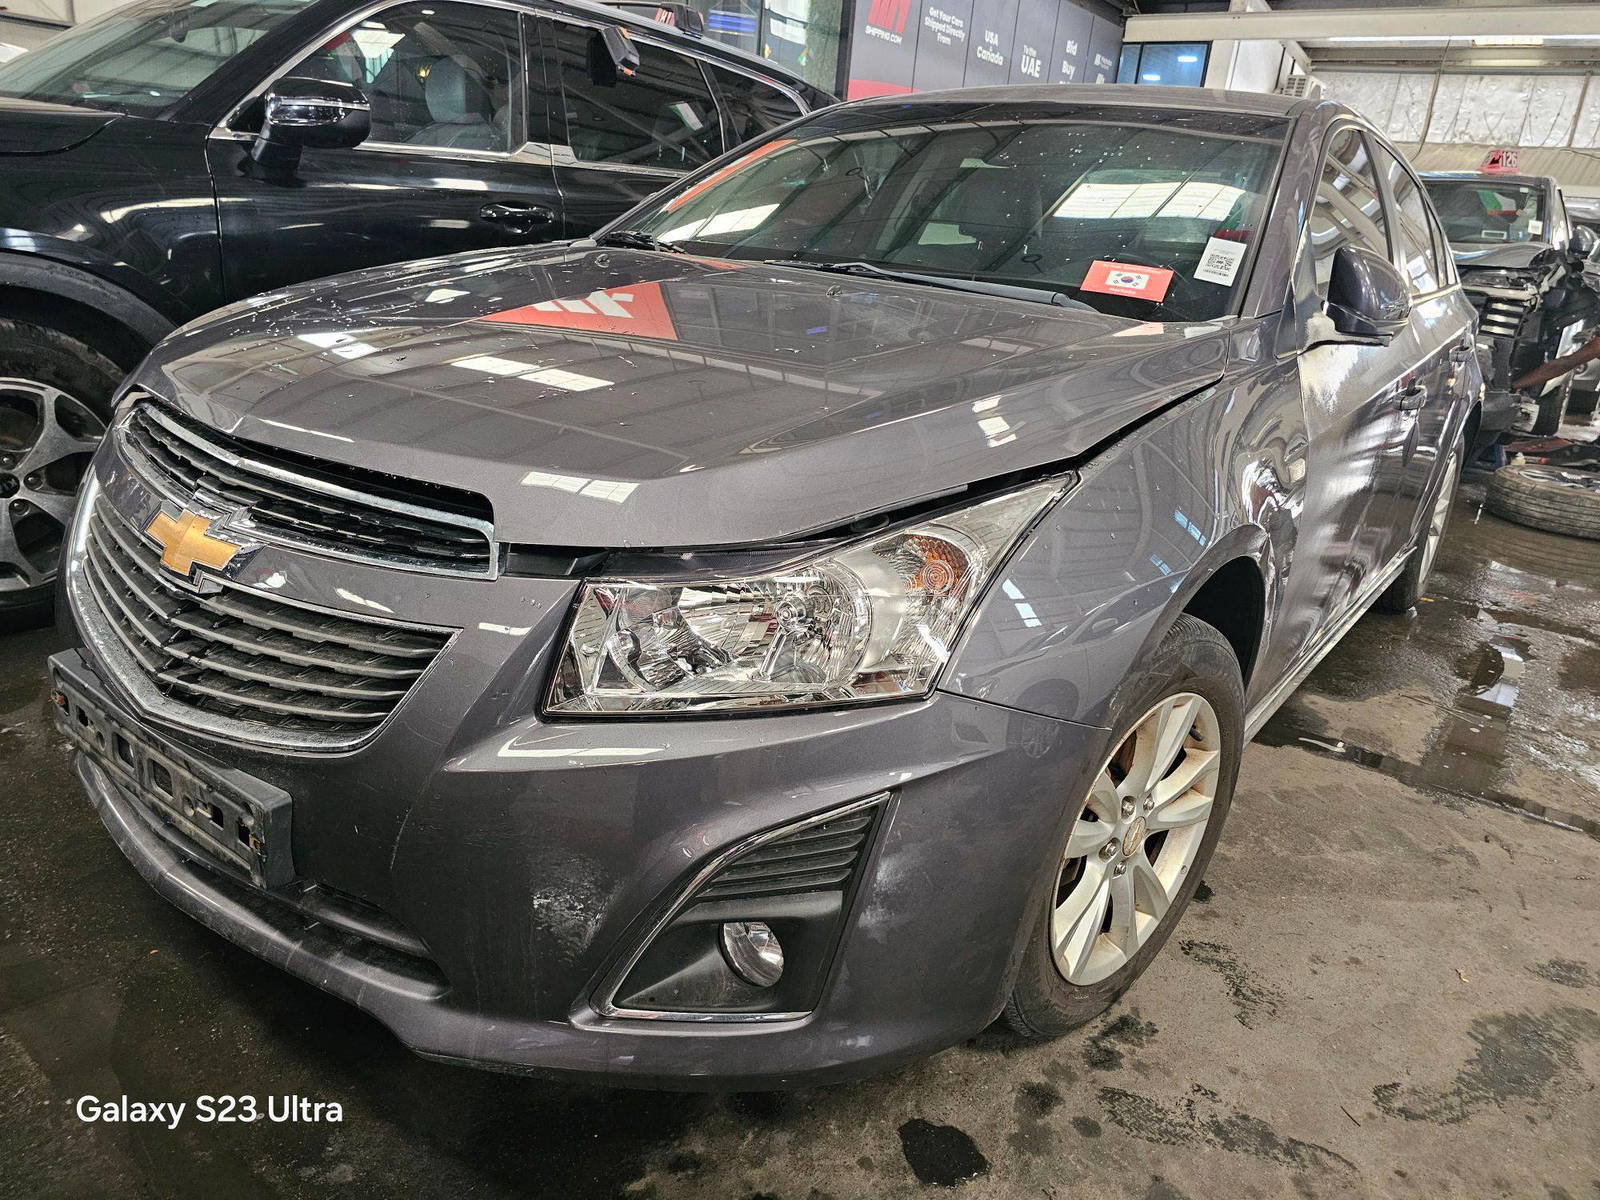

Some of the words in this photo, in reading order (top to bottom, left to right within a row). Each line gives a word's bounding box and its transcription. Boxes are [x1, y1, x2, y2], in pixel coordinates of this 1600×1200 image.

[940, 11, 951, 22] Your
[985, 30, 999, 46] USA
[977, 46, 1004, 66] Canada
[1066, 40, 1078, 56] Bid
[1021, 54, 1042, 78] UAE
[1062, 60, 1076, 80] Buy
[1503, 151, 1517, 168] 126
